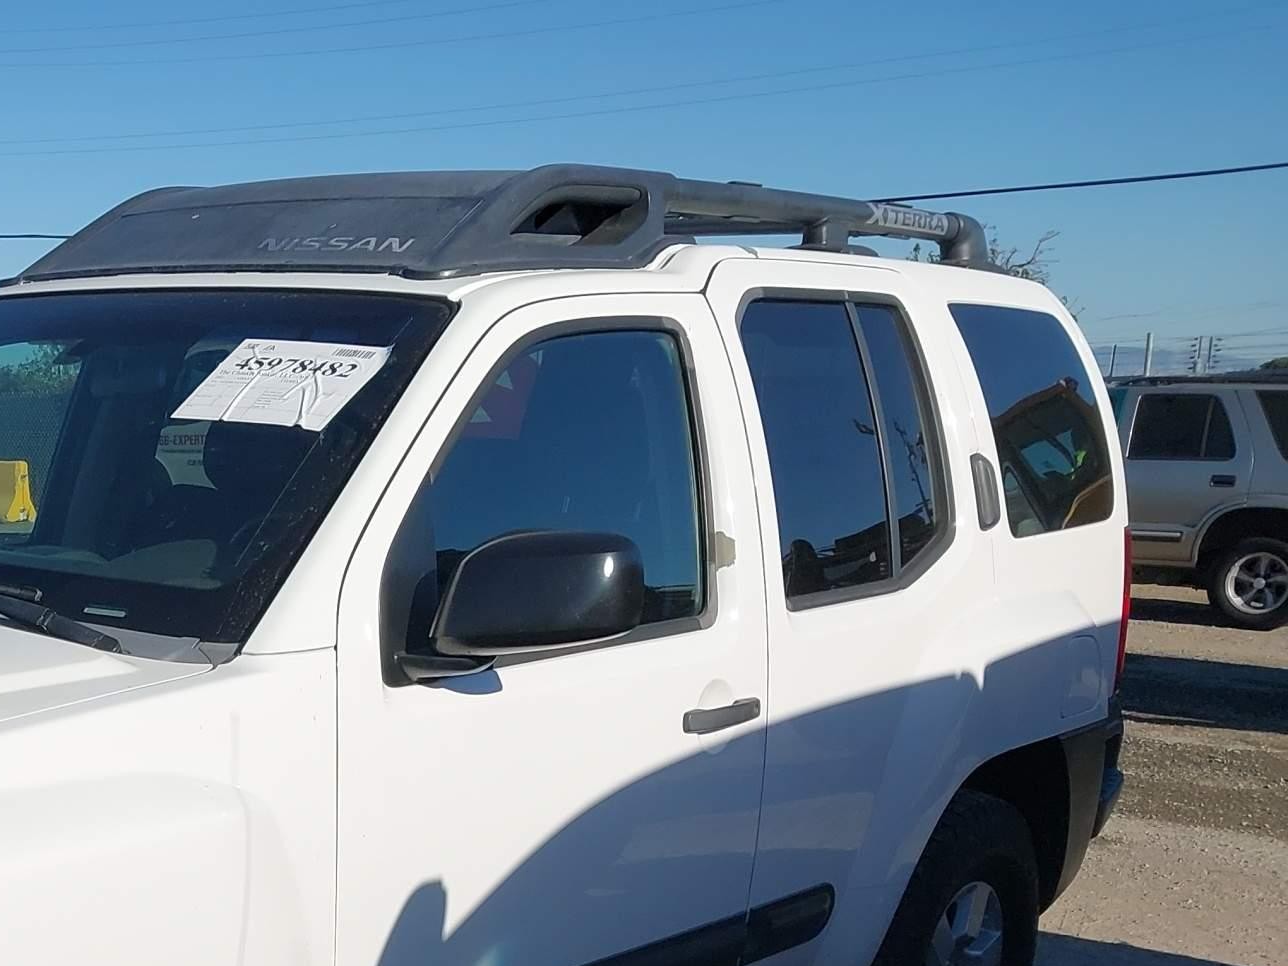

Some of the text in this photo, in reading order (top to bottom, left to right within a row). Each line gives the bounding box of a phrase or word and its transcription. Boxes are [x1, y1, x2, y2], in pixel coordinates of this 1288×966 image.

[866, 202, 948, 234] XTERRA
[257, 236, 415, 252] NISSAN
[235, 357, 359, 378] 45978482
